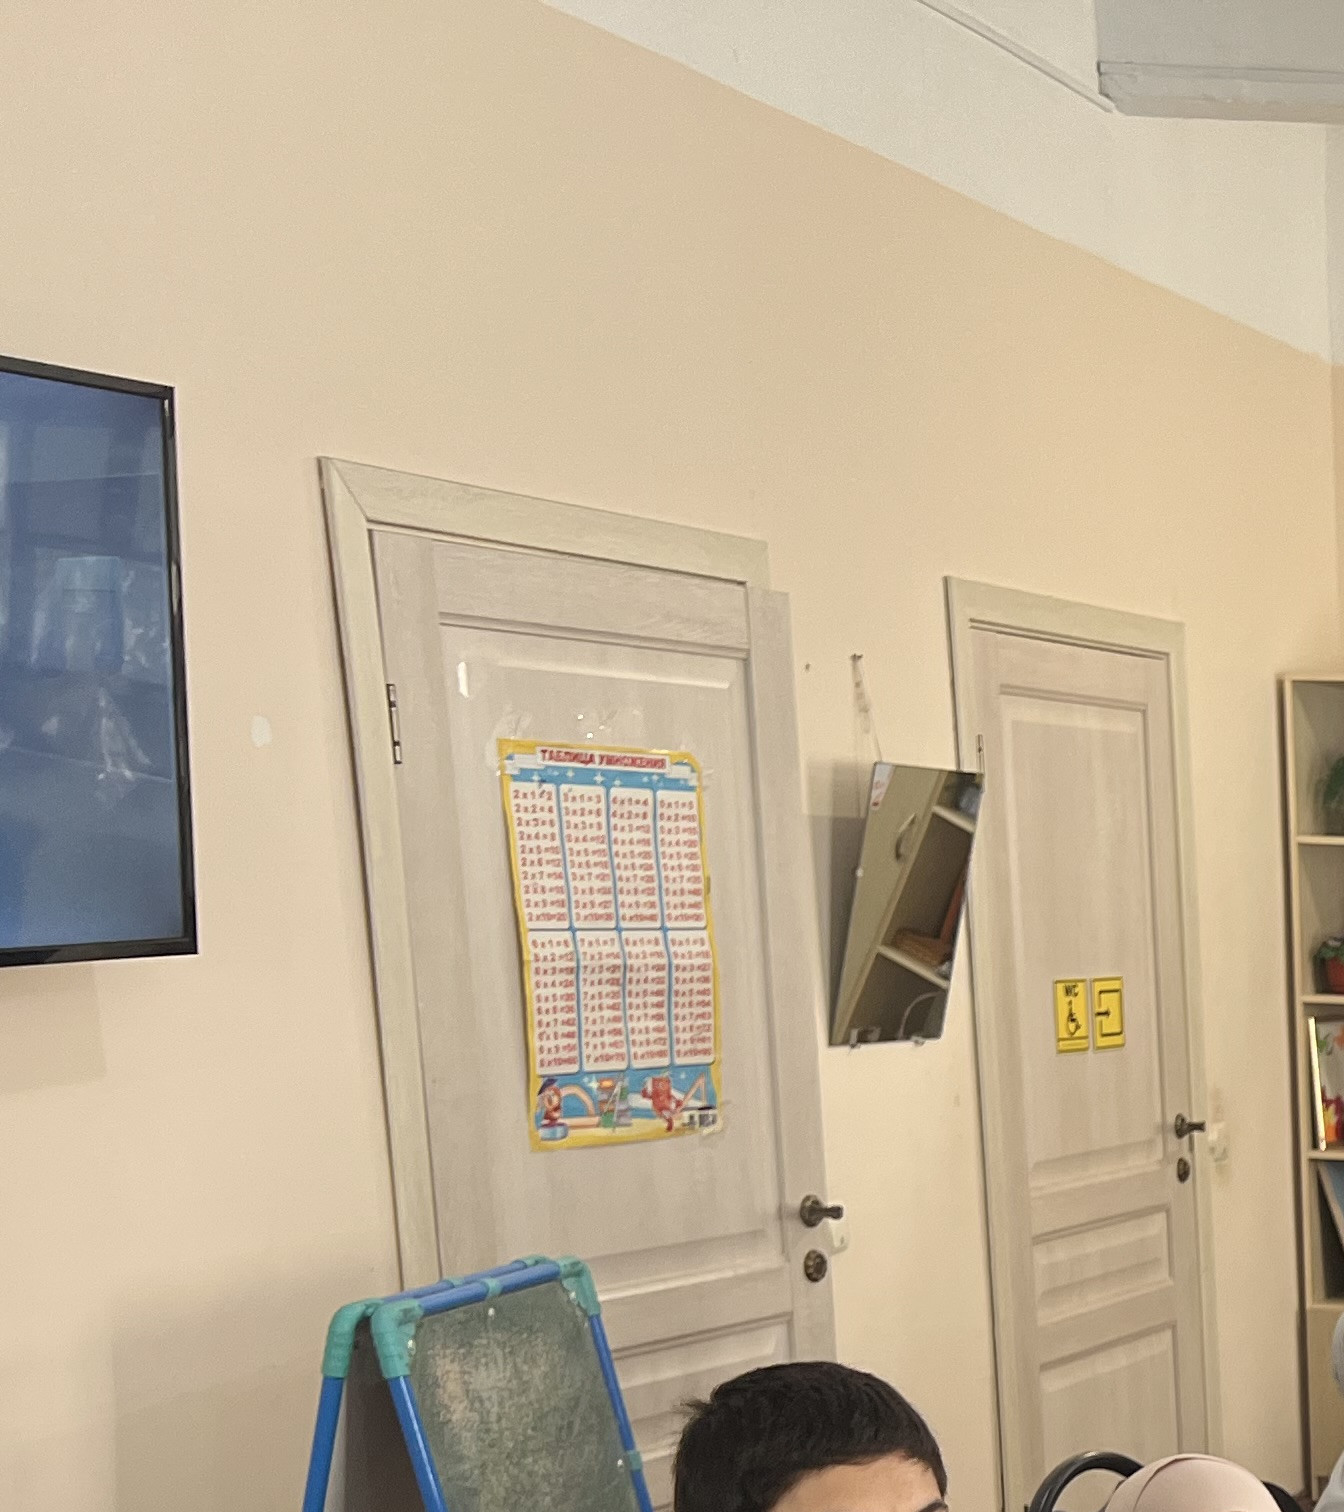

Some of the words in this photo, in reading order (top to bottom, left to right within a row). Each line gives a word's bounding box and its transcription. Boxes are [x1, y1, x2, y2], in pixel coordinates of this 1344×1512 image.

[541, 749, 595, 766] ТАБЛИЦА
[599, 754, 667, 769] УМНОЖЕНИЯ
[1064, 983, 1079, 997] WC
